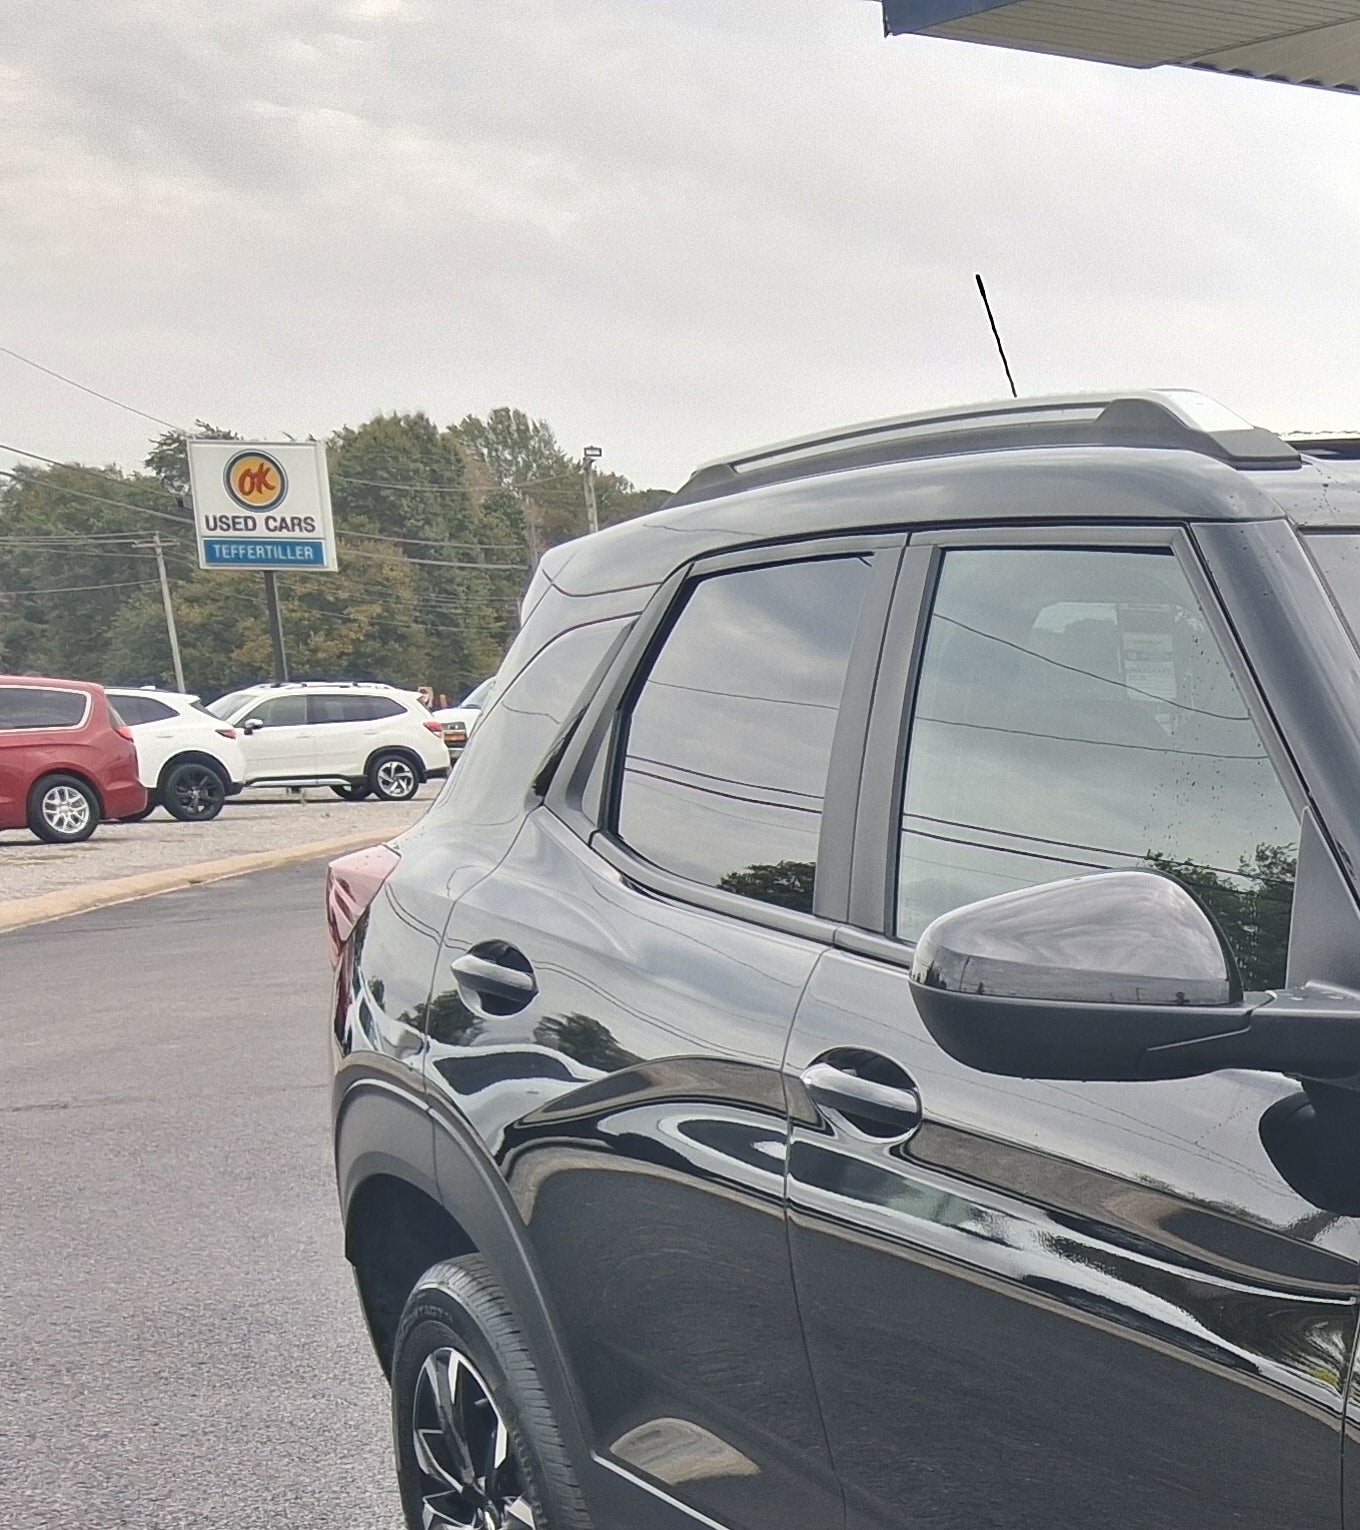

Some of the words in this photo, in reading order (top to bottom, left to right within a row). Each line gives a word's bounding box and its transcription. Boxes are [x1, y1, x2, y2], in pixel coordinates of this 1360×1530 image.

[238, 462, 276, 496] OK
[204, 515, 257, 532] USED
[264, 515, 316, 533] CARS
[212, 544, 314, 560] TEFFERTILLER
